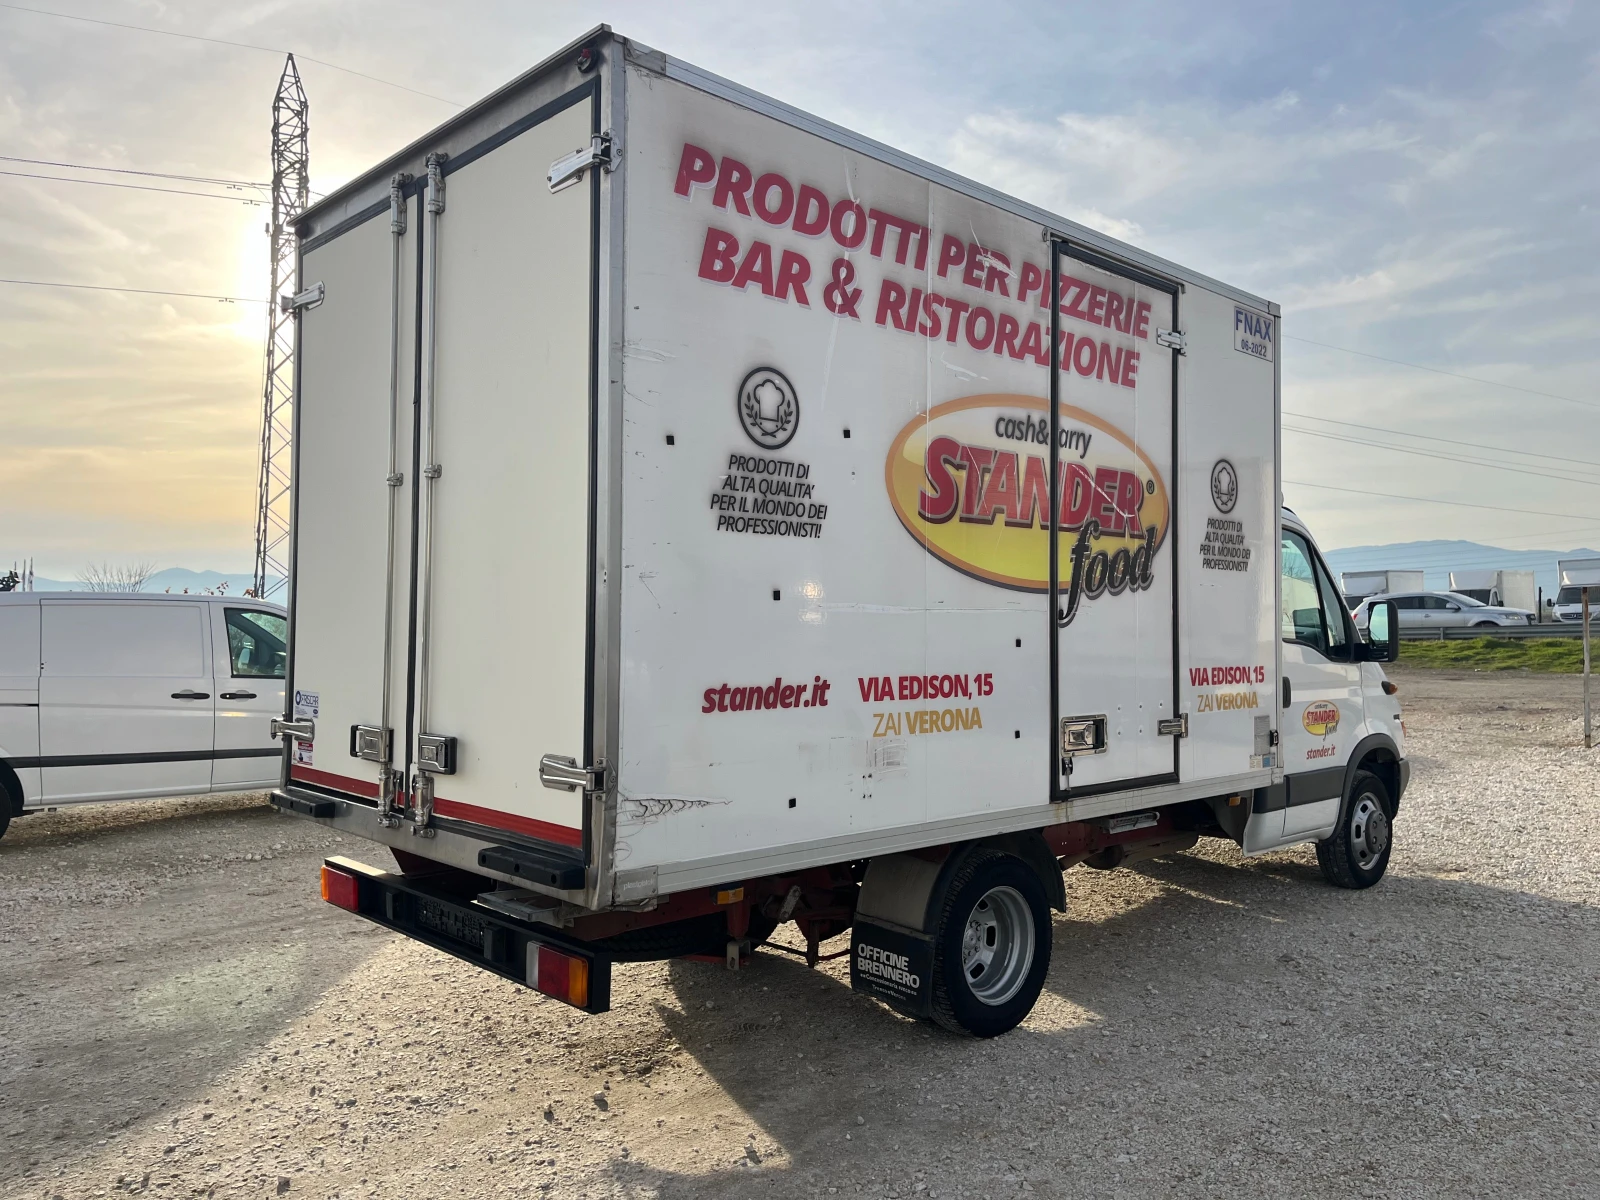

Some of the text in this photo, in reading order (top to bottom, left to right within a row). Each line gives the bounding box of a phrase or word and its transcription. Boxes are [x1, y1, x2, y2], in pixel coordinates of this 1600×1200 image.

[674, 143, 1151, 340] PRODOTTI PER PIZZERIE
[698, 227, 811, 307] BAR
[823, 257, 863, 320] &
[1236, 310, 1271, 342] FNAX
[1241, 339, 1267, 357] 06-2022
[995, 414, 1092, 459] cash&arry
[729, 454, 810, 479] PRODOTTI DI
[722, 475, 815, 499] ALTA QUALITA'
[710, 494, 828, 519] PER IL MONDO DEI
[717, 515, 822, 538] PROFESSIONISTI!
[1204, 532, 1219, 543] ALTA
[1207, 518, 1243, 532] PRODOTTI DI
[1199, 544, 1251, 559] PER IL MONDO DEI
[1058, 520, 1156, 628] food
[858, 673, 993, 702] VIA EDISON, 15
[1189, 665, 1265, 687] VIA EDISON, 15
[701, 675, 830, 713] stander.it
[1197, 691, 1259, 712] ZAI VERONA
[872, 707, 983, 737] ZAI VERONA
[1306, 709, 1336, 726] STANDER
[1306, 743, 1336, 760] stander.it
[858, 943, 909, 971] OFFICINE
[857, 957, 920, 989] BRENNERO
